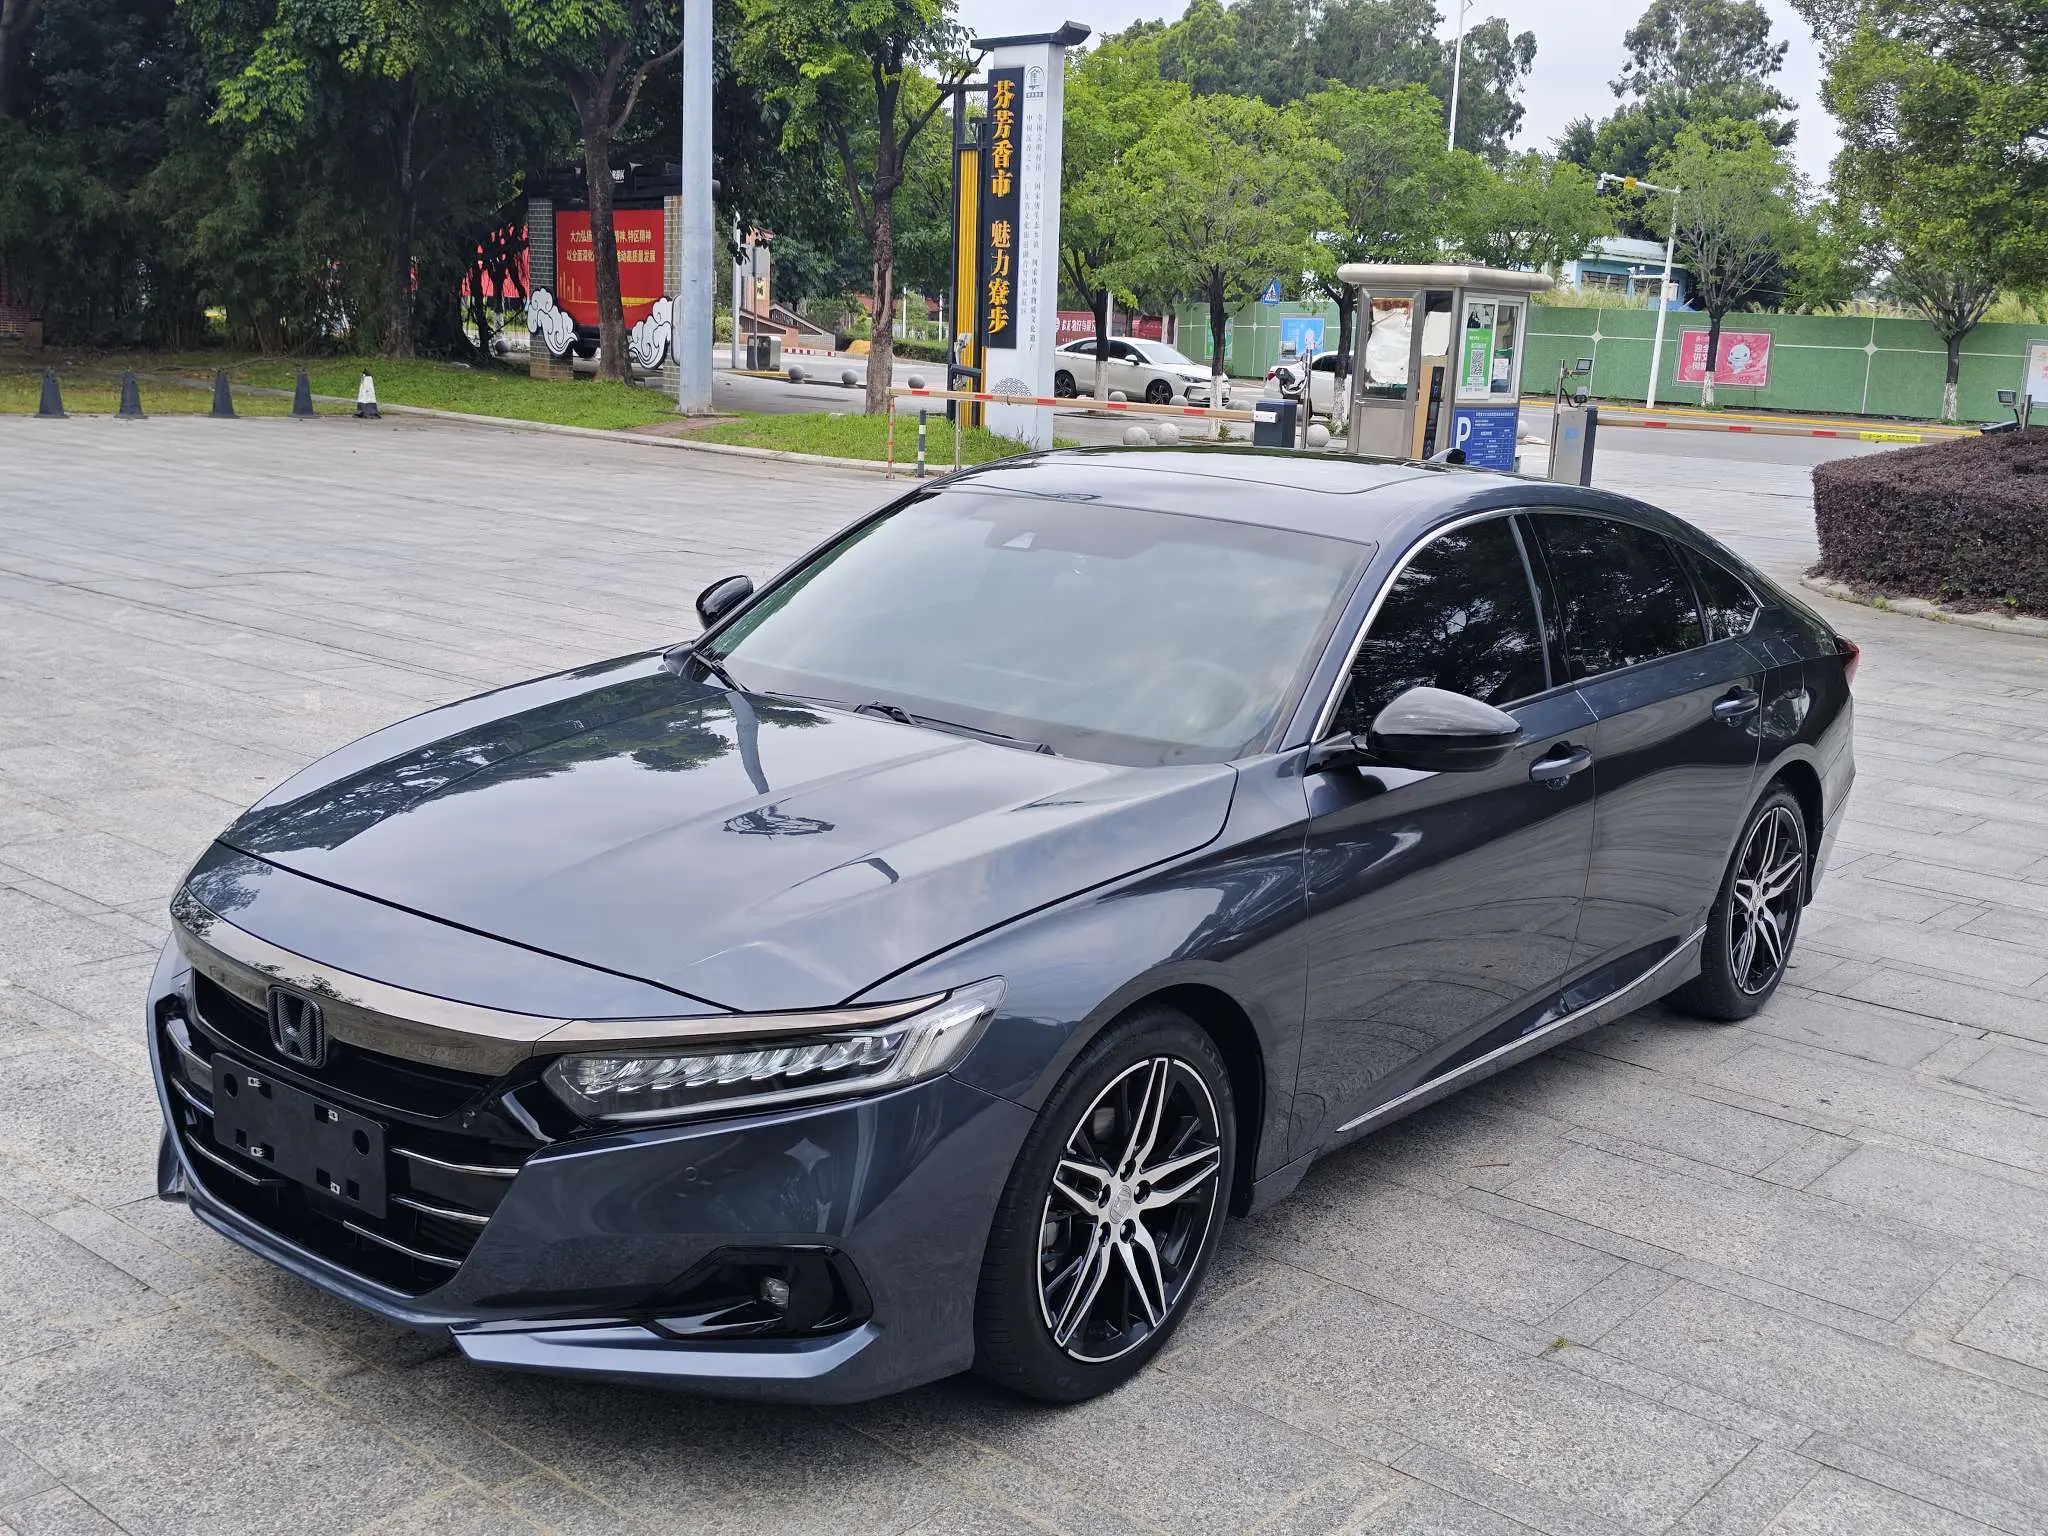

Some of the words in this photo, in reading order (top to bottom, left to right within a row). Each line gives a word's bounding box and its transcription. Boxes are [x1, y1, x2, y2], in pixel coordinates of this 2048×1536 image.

[991, 80, 1016, 198] 芬芳香市
[988, 220, 1011, 334] 魅力寮步
[1456, 416, 1471, 449] P
